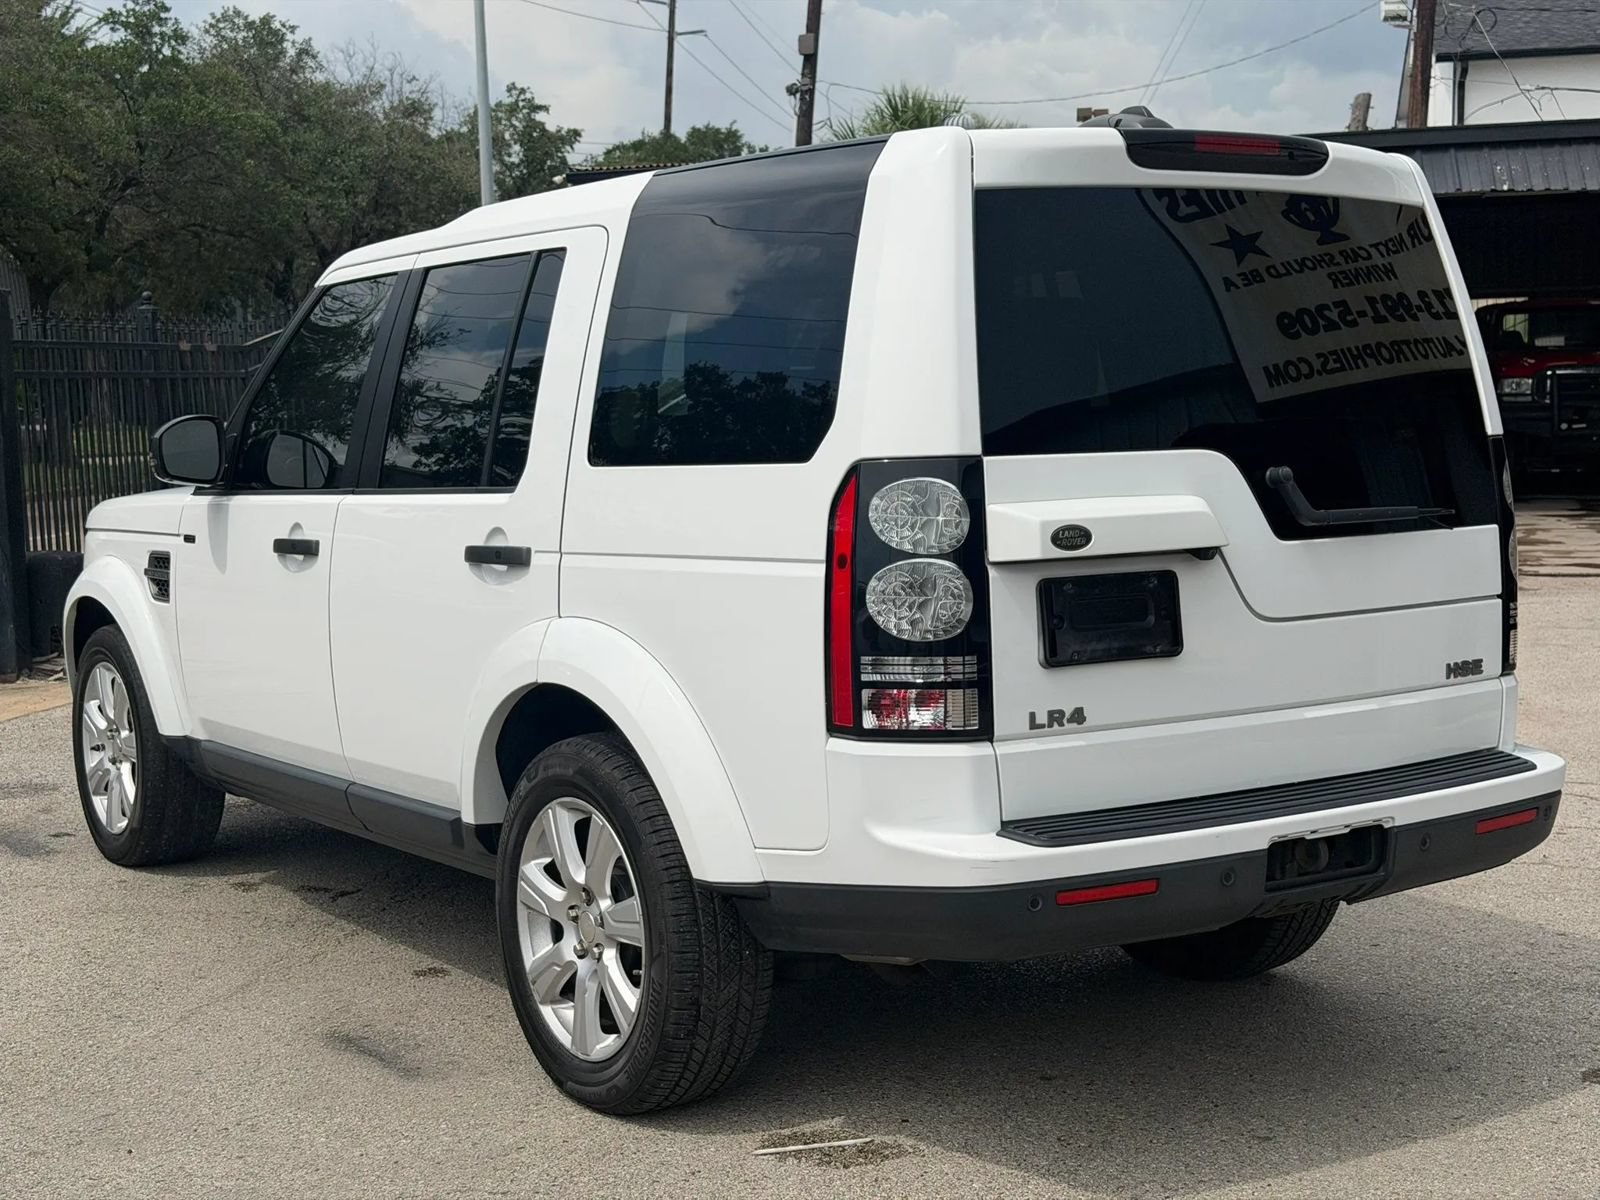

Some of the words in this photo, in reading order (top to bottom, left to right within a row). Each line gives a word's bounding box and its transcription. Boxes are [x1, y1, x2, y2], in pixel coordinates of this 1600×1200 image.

[1059, 530, 1080, 539] LAND
[1061, 537, 1087, 547] ROVER
[1445, 658, 1484, 680] HSE
[1028, 706, 1087, 731] LR4
